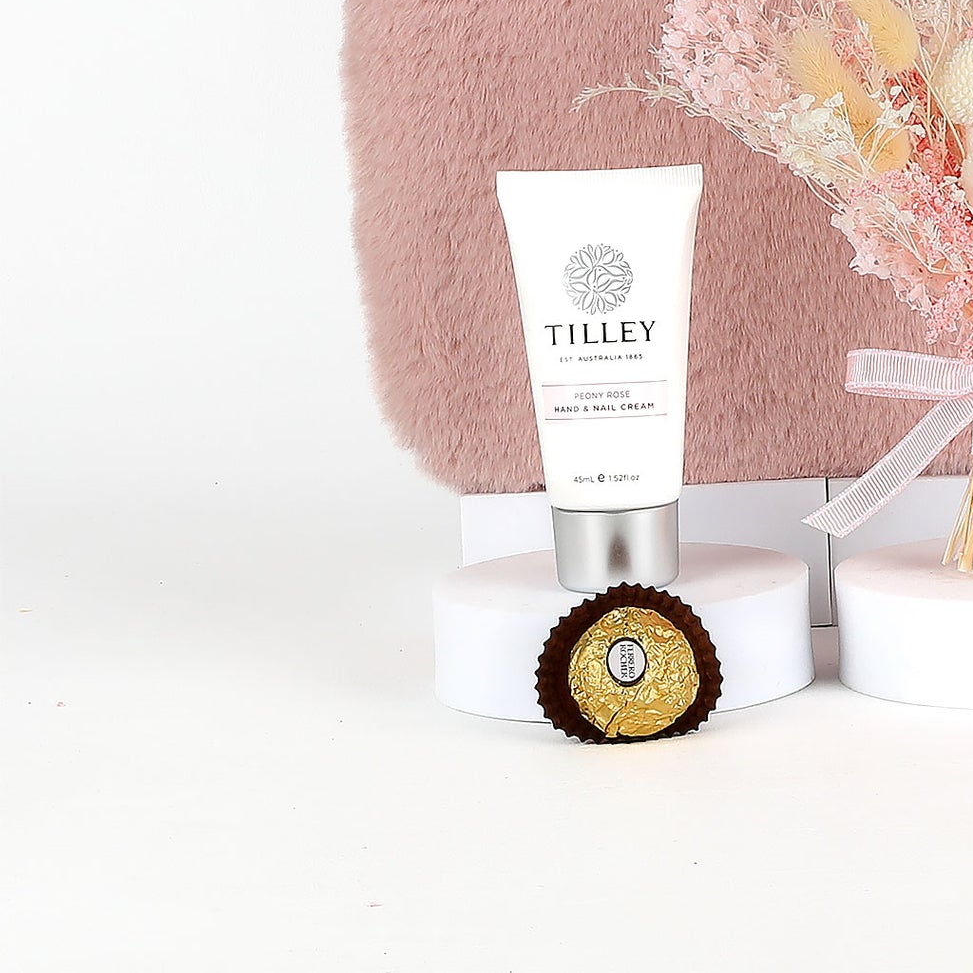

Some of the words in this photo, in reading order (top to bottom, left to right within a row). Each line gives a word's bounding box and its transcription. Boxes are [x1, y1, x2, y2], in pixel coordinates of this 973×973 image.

[544, 320, 656, 346] TILLEY
[578, 354, 622, 362] AUSTRALIA
[574, 392, 604, 400] PEONY
[606, 390, 631, 399] ROSE
[620, 402, 655, 411] CREAM
[608, 474, 629, 482] 152fl
